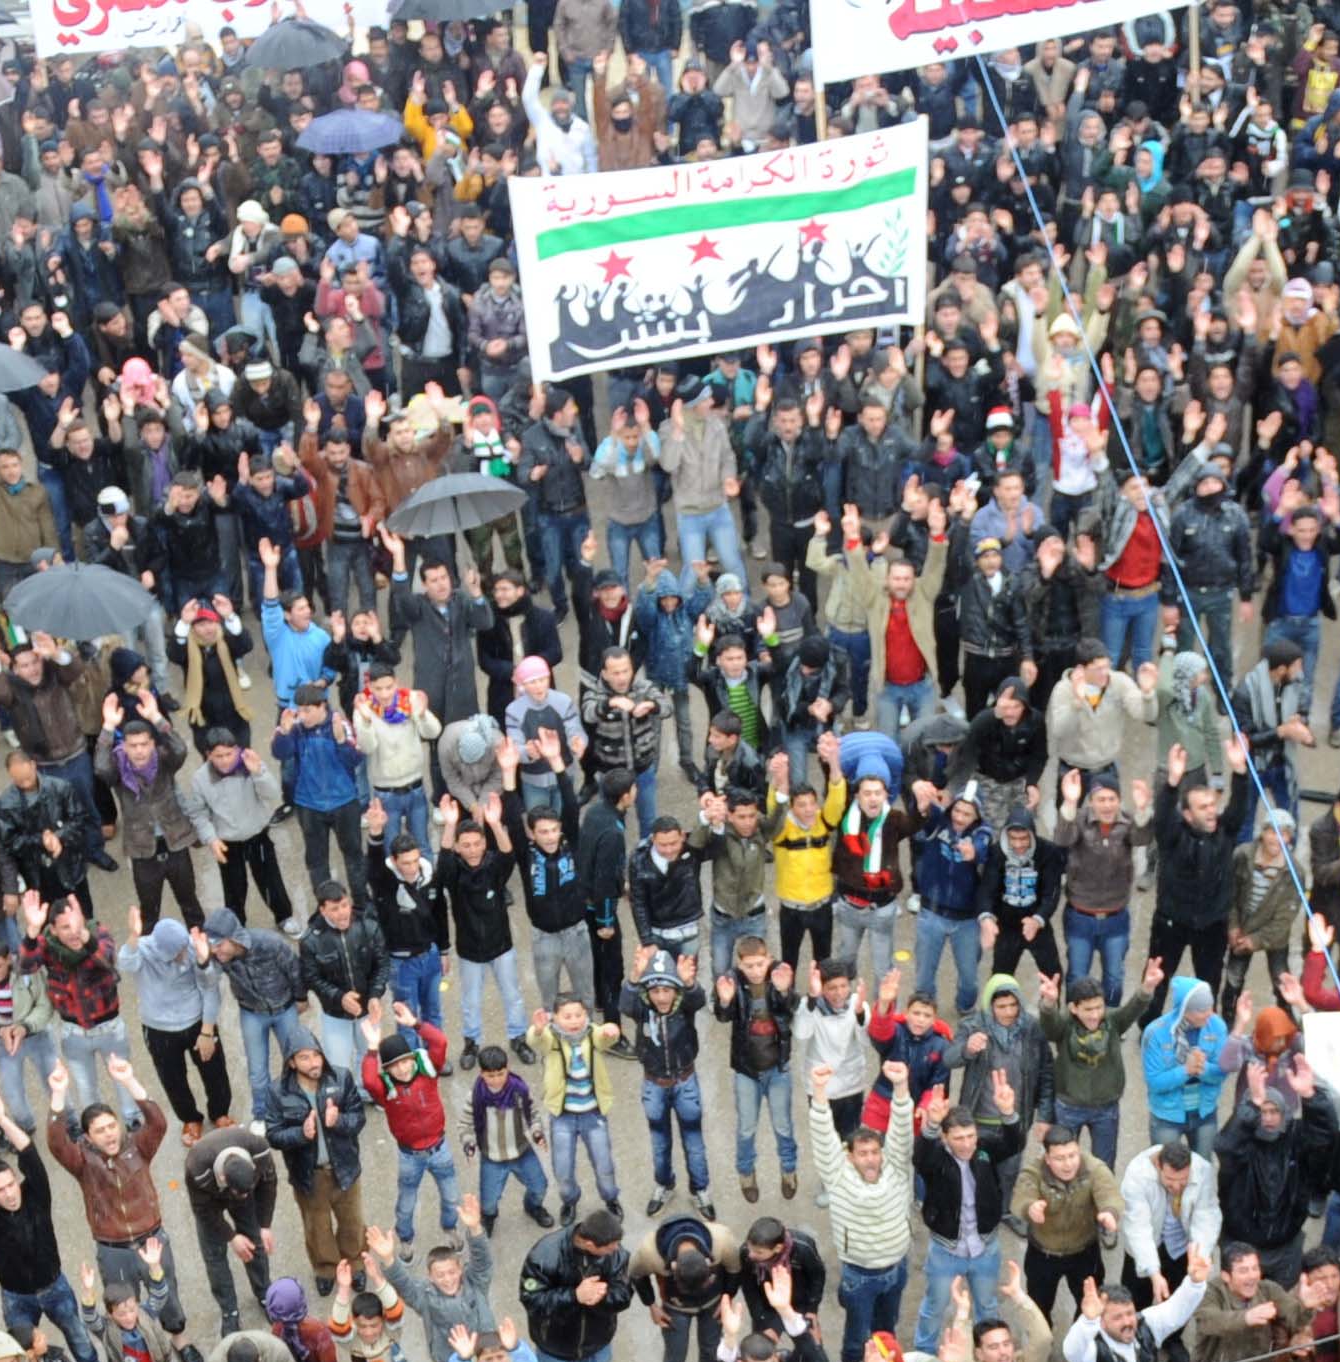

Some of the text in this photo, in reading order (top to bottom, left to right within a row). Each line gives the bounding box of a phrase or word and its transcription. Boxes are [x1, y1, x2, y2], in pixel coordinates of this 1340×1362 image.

[543, 136, 891, 221] ثورة الكرامة السورية
[564, 308, 713, 361] بنش
